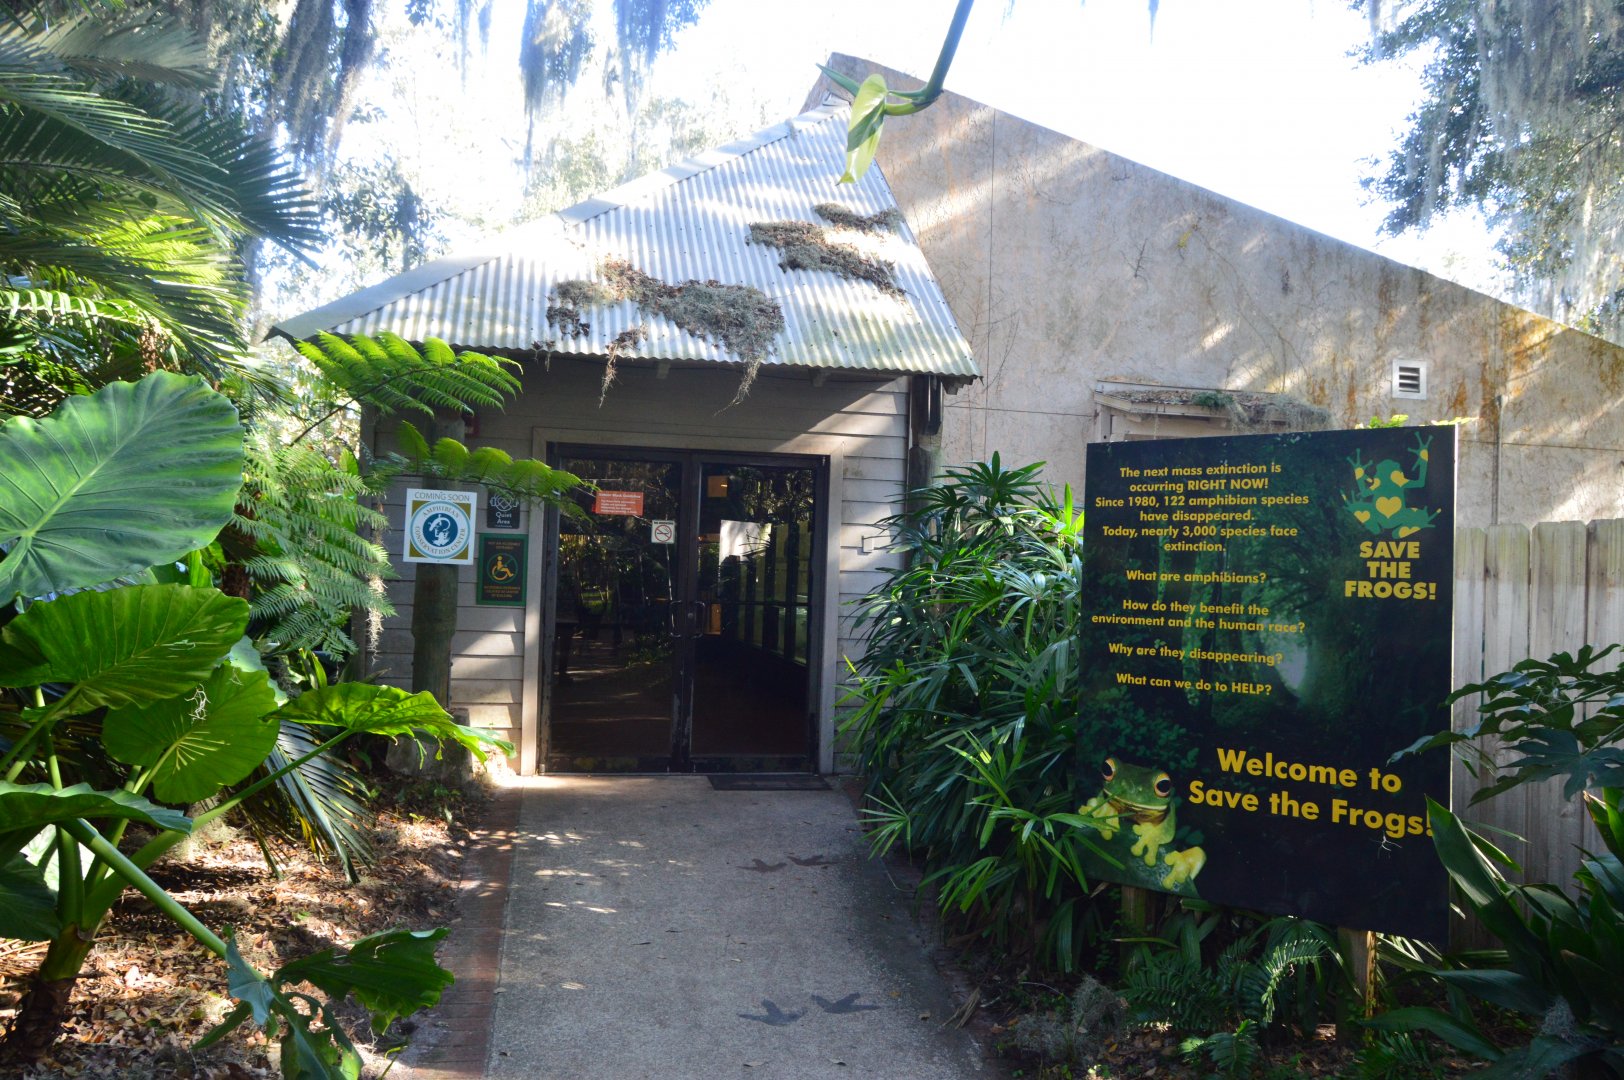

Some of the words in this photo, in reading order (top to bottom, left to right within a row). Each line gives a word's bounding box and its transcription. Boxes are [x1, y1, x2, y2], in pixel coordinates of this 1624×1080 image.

[1120, 467, 1140, 477] The
[1144, 467, 1168, 477] next
[1172, 467, 1202, 476] mass
[1206, 463, 1266, 475] extinction
[1271, 462, 1281, 473] is
[1130, 481, 1183, 493] occurring
[1188, 480, 1226, 491] RIGHT
[1231, 478, 1269, 489] NOW!
[415, 492, 446, 500] COMING
[1095, 497, 1124, 507] Since
[1128, 497, 1159, 508] 1980,
[1164, 496, 1185, 506] 122
[1188, 495, 1257, 507] amphibian
[1261, 493, 1309, 505] species
[423, 506, 459, 517] AMPHIBIAN
[1140, 511, 1168, 521] have
[1172, 510, 1255, 523] disappeared.
[1103, 526, 1138, 538] Today,
[1141, 526, 1179, 538] nearly
[1182, 526, 1217, 538] 3,000
[1220, 525, 1266, 538] species
[1270, 525, 1298, 536] face
[415, 526, 450, 554] CONSERVATION
[1164, 541, 1226, 552] extinction.
[1359, 541, 1420, 558] SAVE
[1126, 570, 1157, 581] What
[1159, 573, 1180, 581] are
[1184, 573, 1266, 584] amphibians?
[1367, 562, 1411, 579] THE
[1345, 581, 1437, 600] FROGS!
[1123, 600, 1148, 611] How
[1151, 601, 1166, 611] do
[1170, 602, 1196, 614] they
[1200, 602, 1244, 615] benefit
[1247, 605, 1269, 616] the
[1091, 614, 1164, 626] environment
[1168, 617, 1191, 628] and
[1195, 618, 1215, 629] the
[1219, 619, 1264, 631] human
[1268, 622, 1305, 633] race?
[1108, 643, 1133, 656] Why
[1136, 647, 1157, 656] are
[1160, 647, 1185, 660] they
[1189, 649, 1283, 666] disappearing?
[1117, 673, 1146, 685] What
[1150, 678, 1171, 687] can
[1174, 680, 1192, 689] we
[1195, 679, 1211, 691] do
[1215, 682, 1227, 692] to
[1232, 683, 1272, 695] HELP?
[1217, 748, 1357, 788] Welcome
[1369, 768, 1401, 793] to
[1189, 780, 1258, 812] Save
[1269, 791, 1319, 820] the
